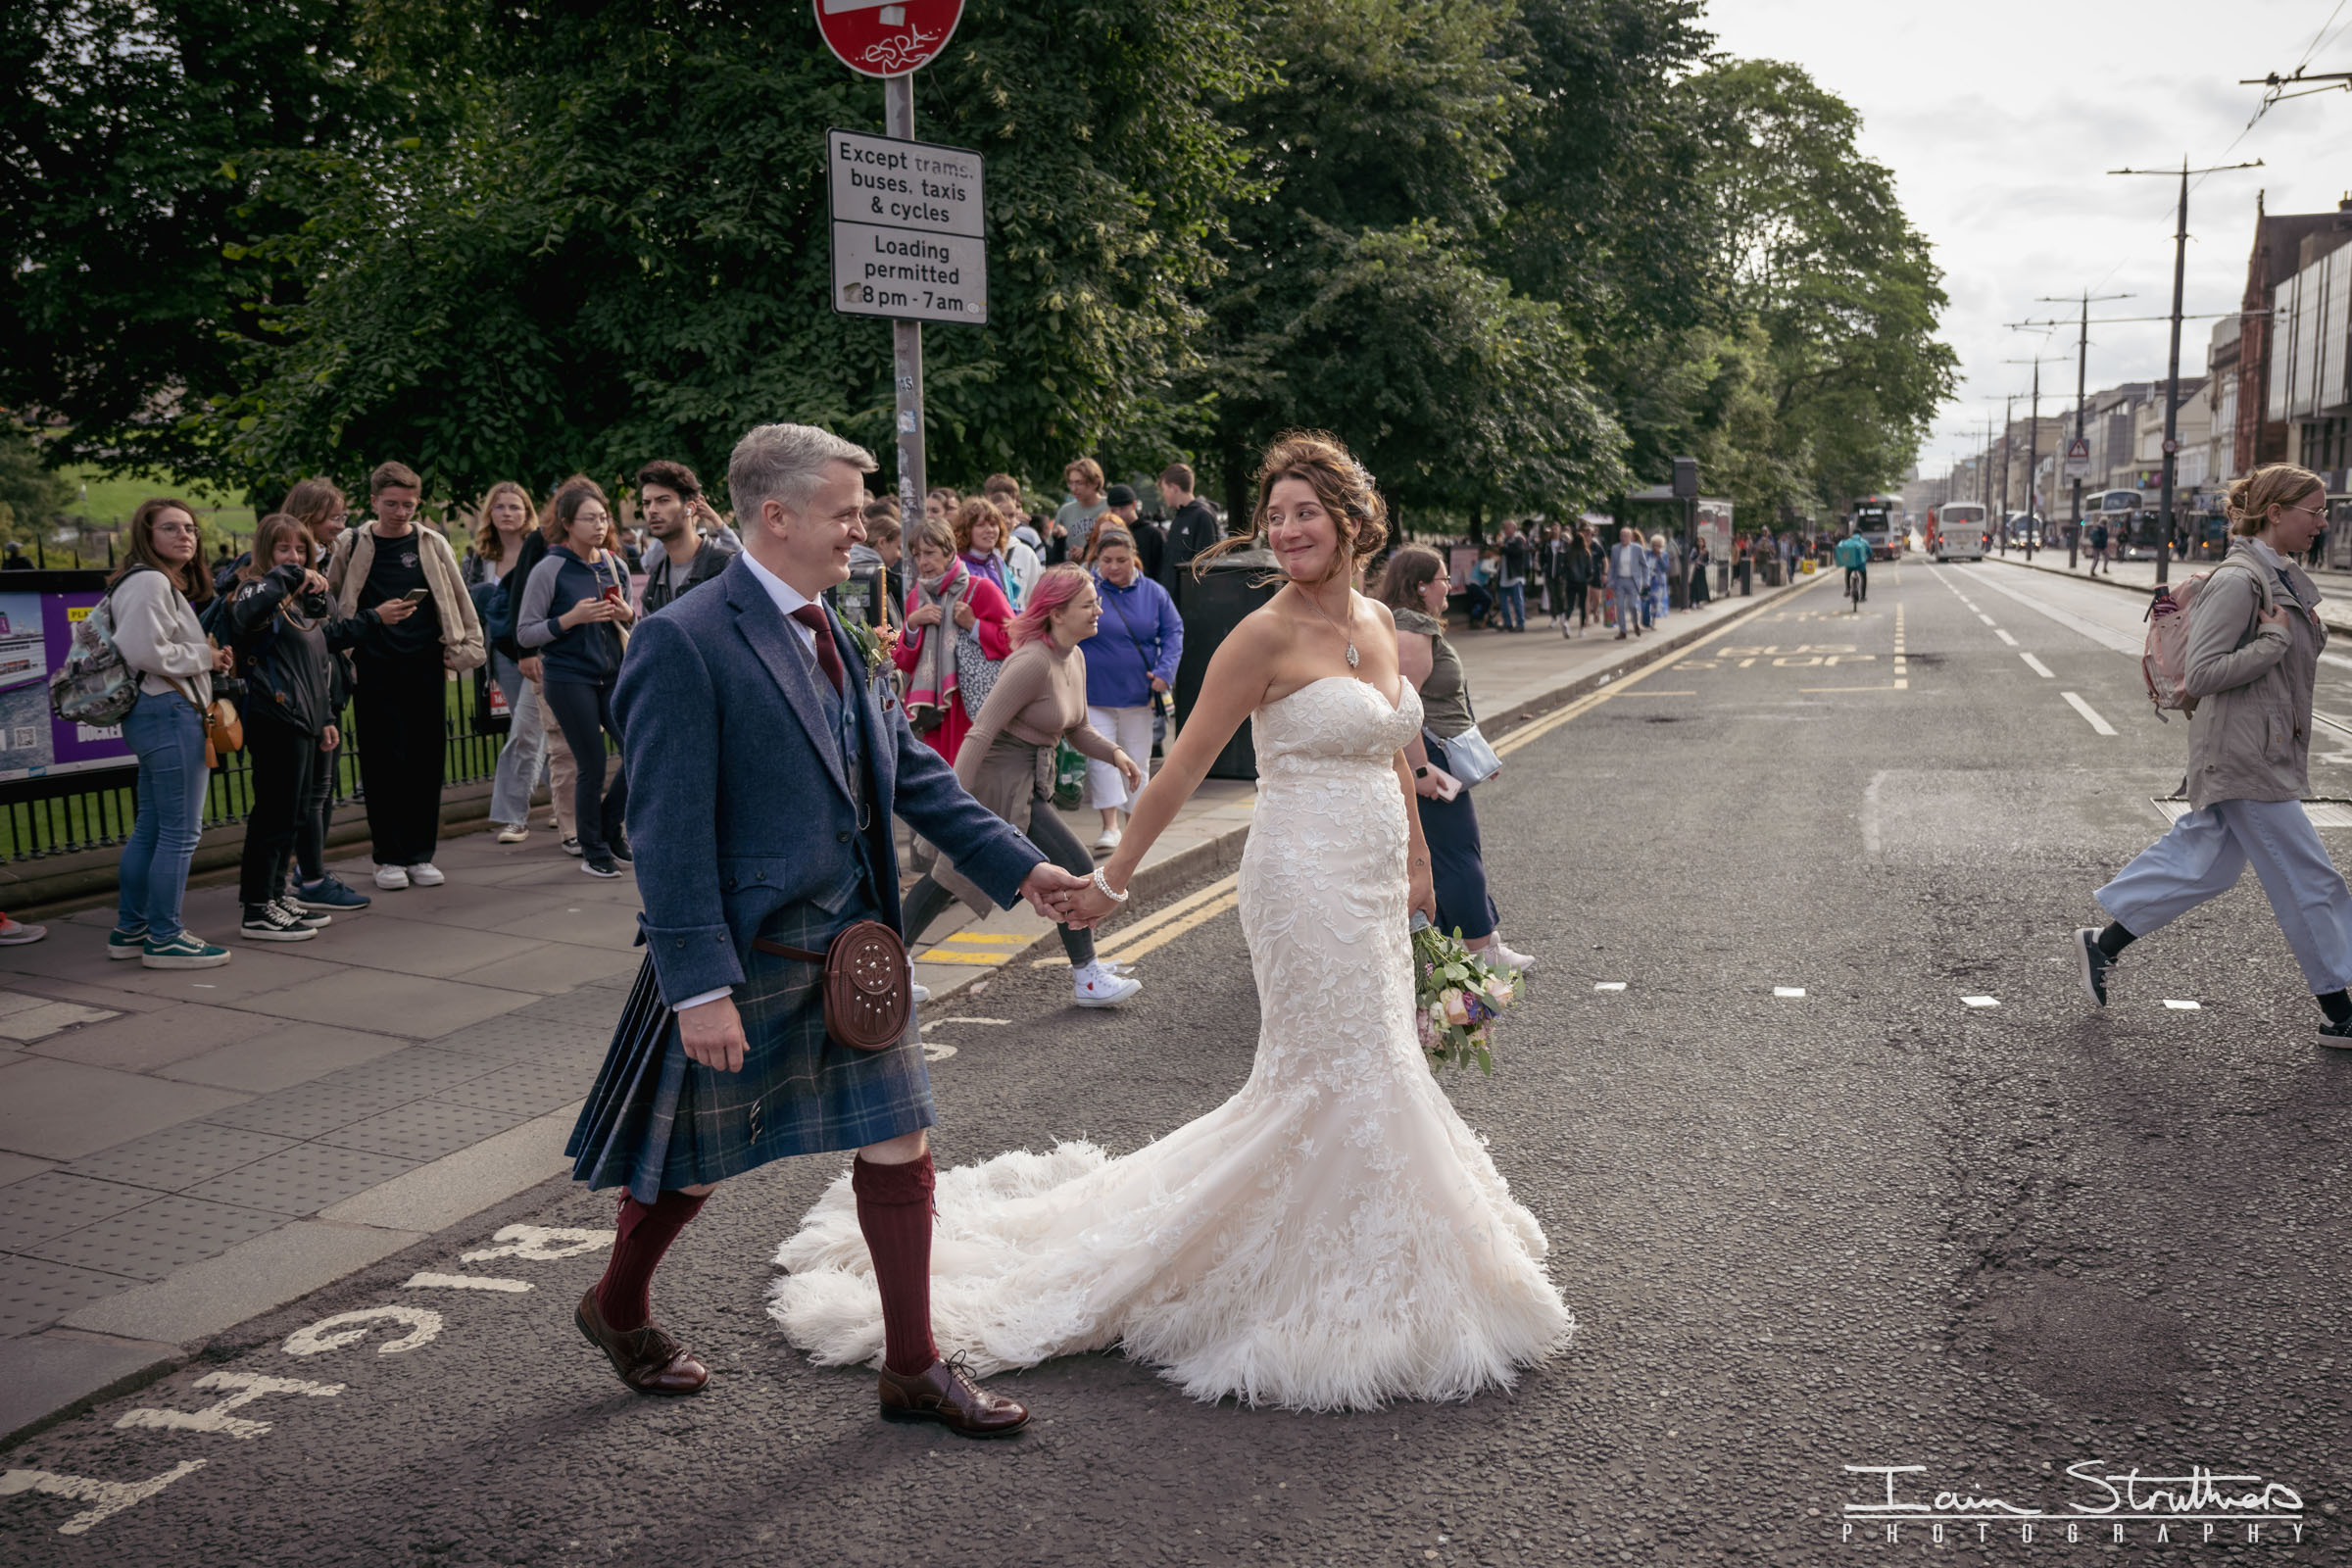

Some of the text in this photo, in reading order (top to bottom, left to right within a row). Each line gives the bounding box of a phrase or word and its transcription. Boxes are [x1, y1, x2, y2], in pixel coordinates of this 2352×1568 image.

[840, 142, 907, 171] Except
[921, 179, 966, 202] taxis
[871, 196, 950, 222] & cycles
[875, 235, 950, 264] Loading
[865, 263, 959, 284] permitted
[1071, 517, 1095, 537] OXFO
[1717, 643, 1857, 657] BUS
[1672, 655, 1876, 670] STOP
